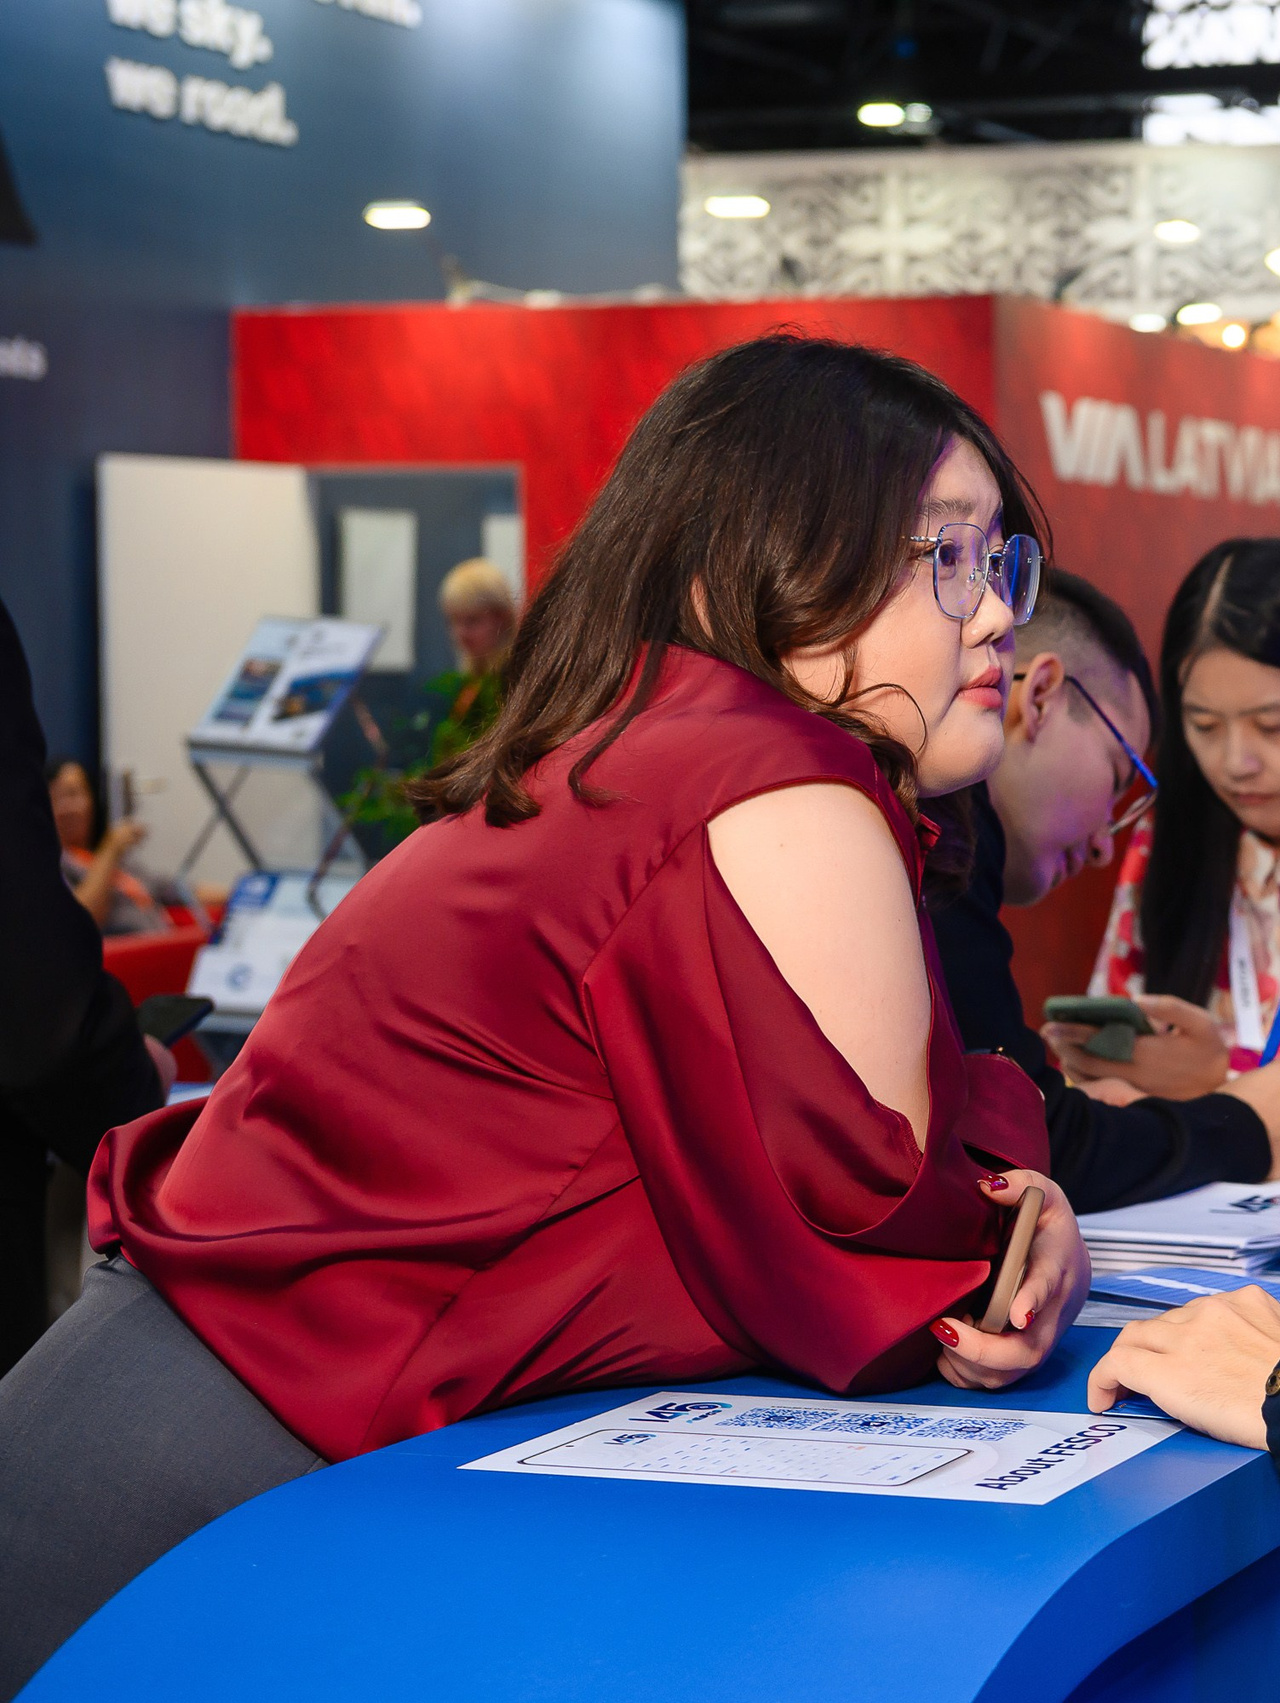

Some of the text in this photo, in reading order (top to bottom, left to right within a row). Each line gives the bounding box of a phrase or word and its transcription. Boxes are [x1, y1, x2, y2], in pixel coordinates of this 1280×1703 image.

[105, 56, 299, 147] we road.
[975, 1457, 1065, 1491] About
[1038, 1424, 1127, 1456] FESCO
